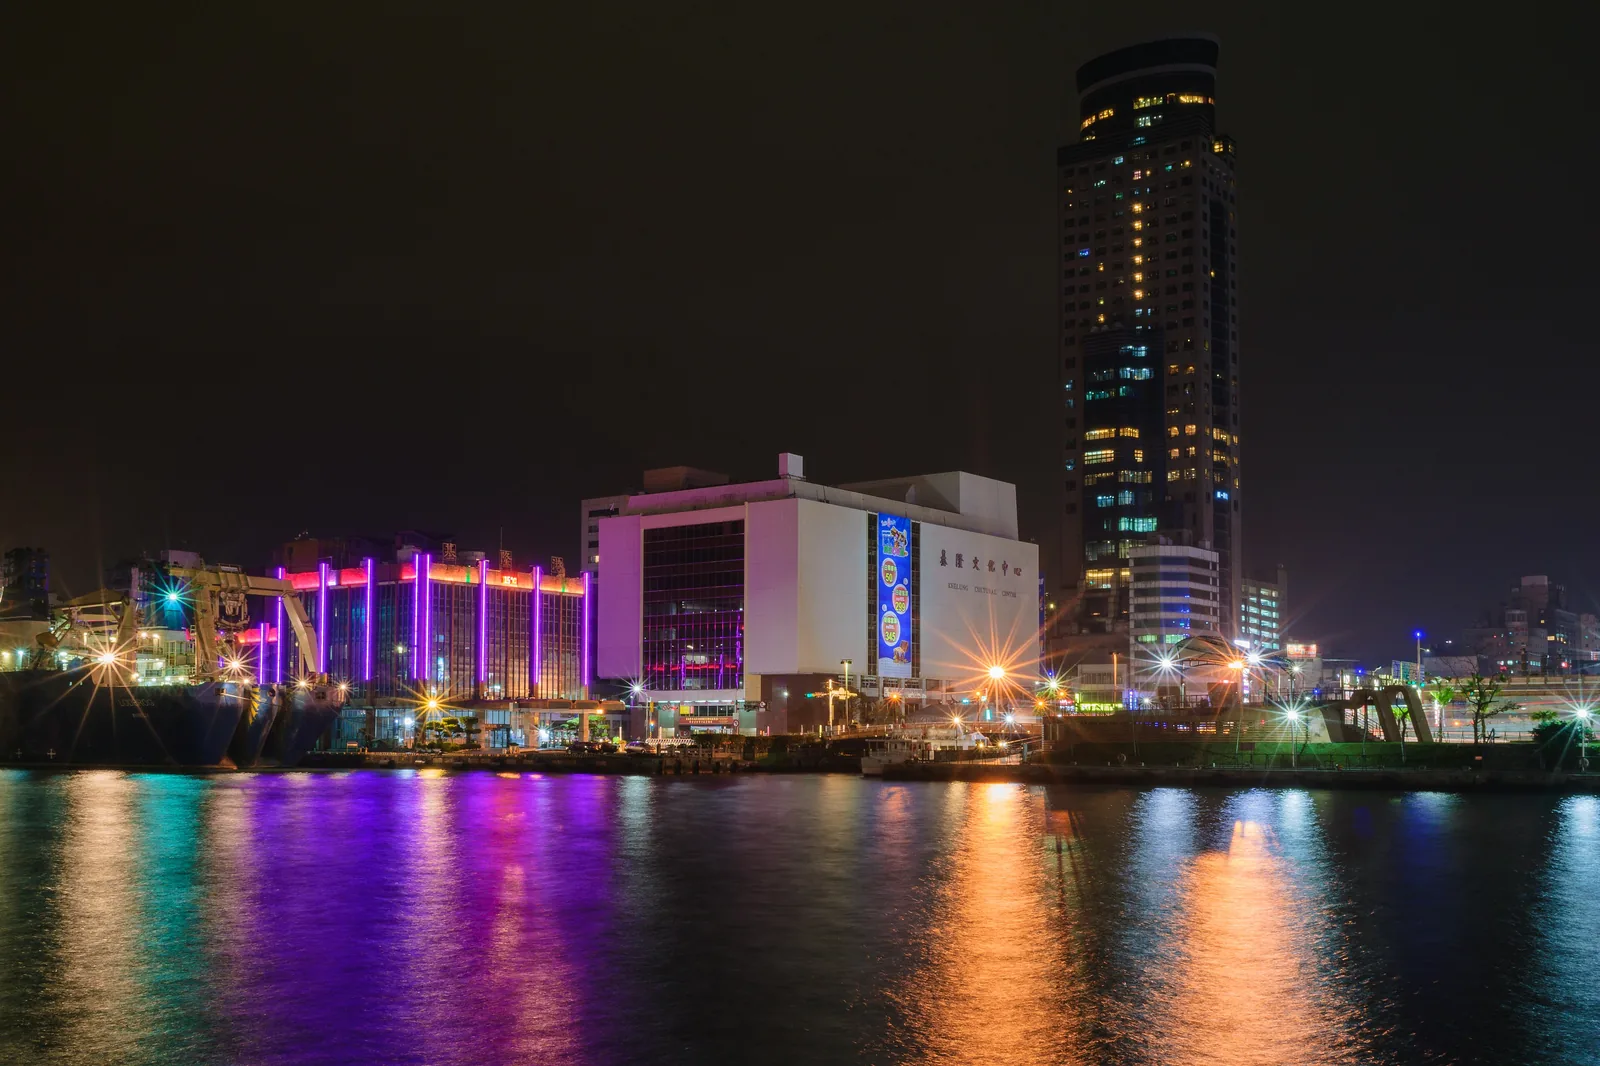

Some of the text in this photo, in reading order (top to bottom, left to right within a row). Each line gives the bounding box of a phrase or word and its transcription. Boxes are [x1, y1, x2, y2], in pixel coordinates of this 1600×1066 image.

[940, 549, 1022, 577] 基隆文化中心
[885, 573, 893, 583] 50
[948, 582, 969, 592] KEELUNG
[1002, 590, 1017, 598] CENT
[895, 601, 906, 613] 299
